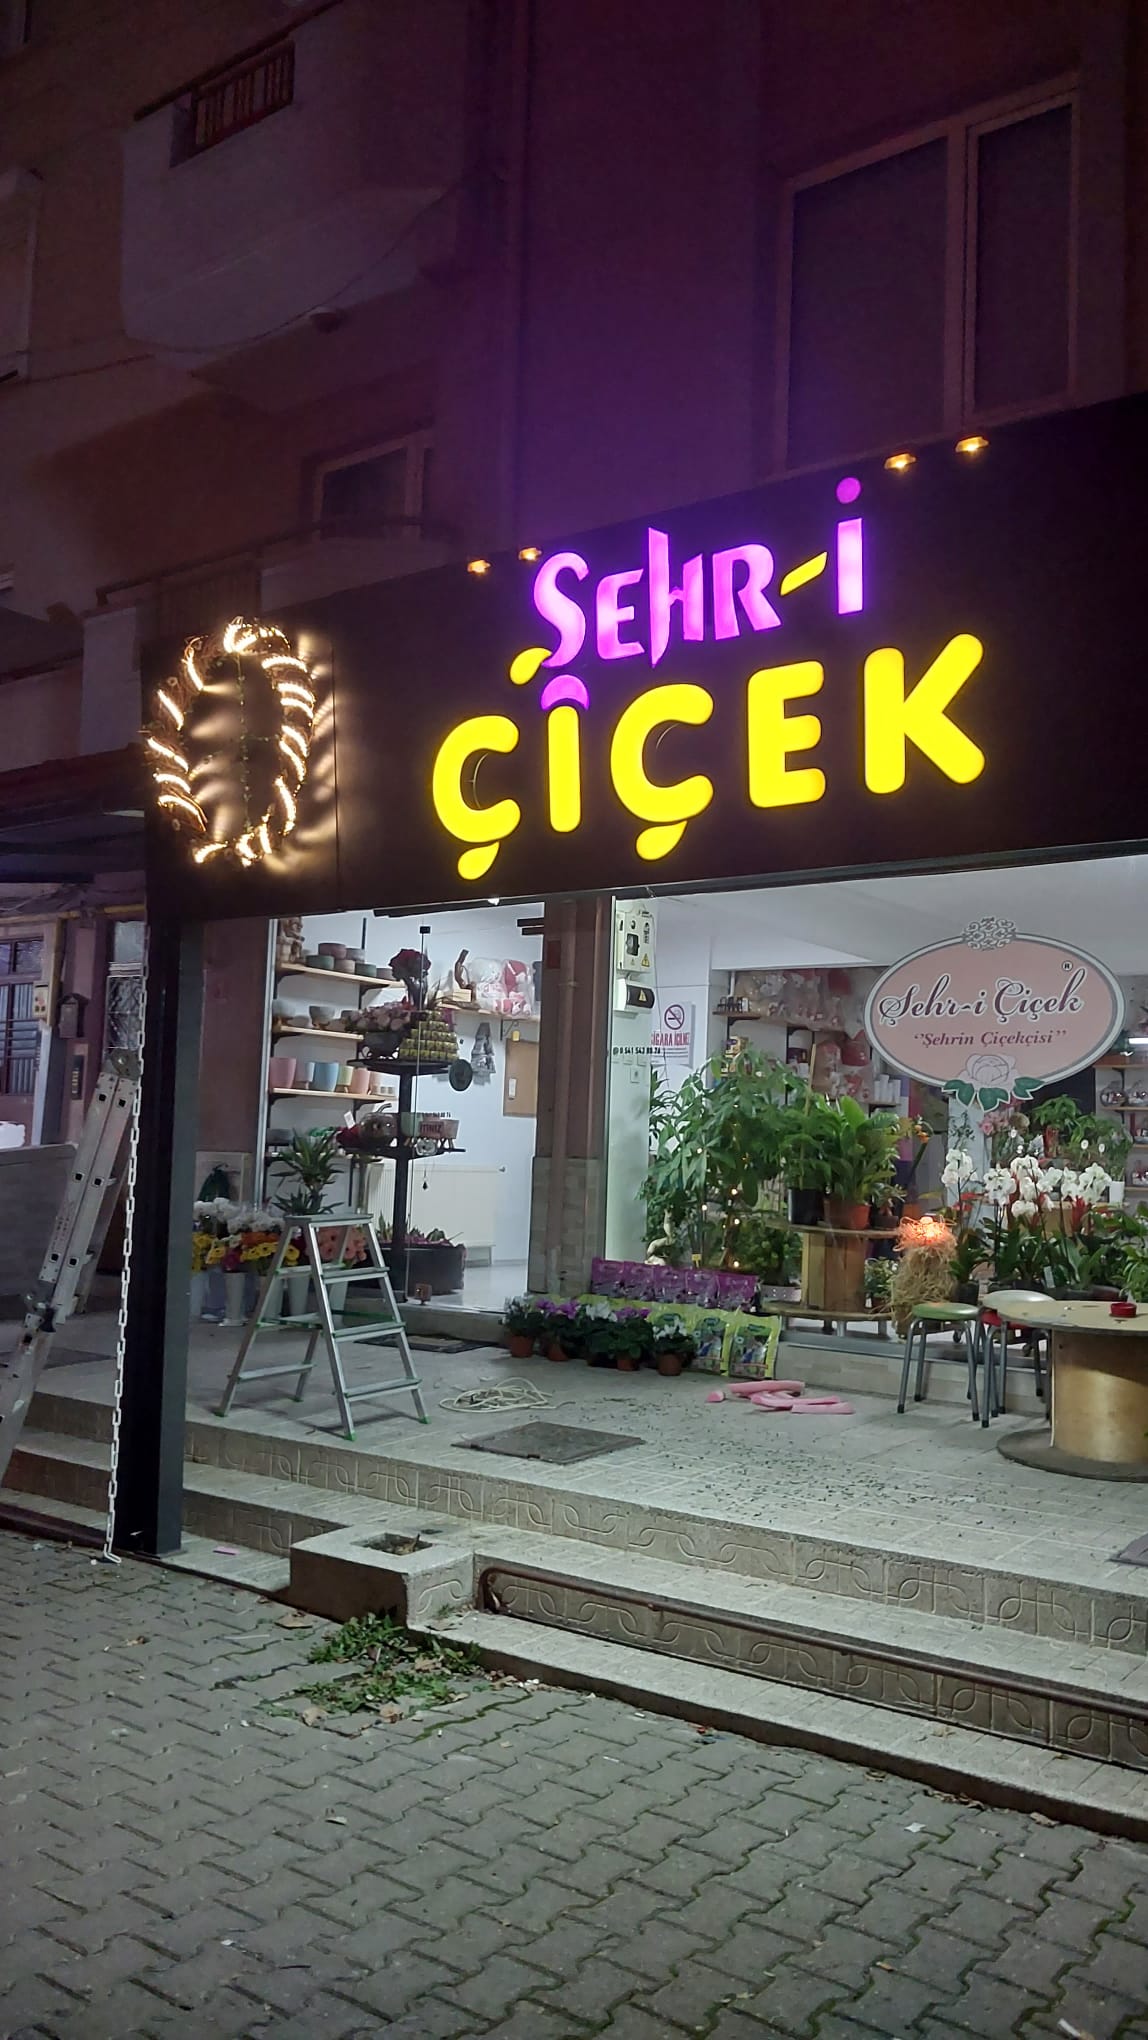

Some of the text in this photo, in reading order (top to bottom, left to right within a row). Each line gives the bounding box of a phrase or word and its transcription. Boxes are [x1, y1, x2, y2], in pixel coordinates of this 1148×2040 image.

[432, 633, 986, 881] ÇİÇEK
[878, 967, 1087, 1026] Şehr-i Çiçek
